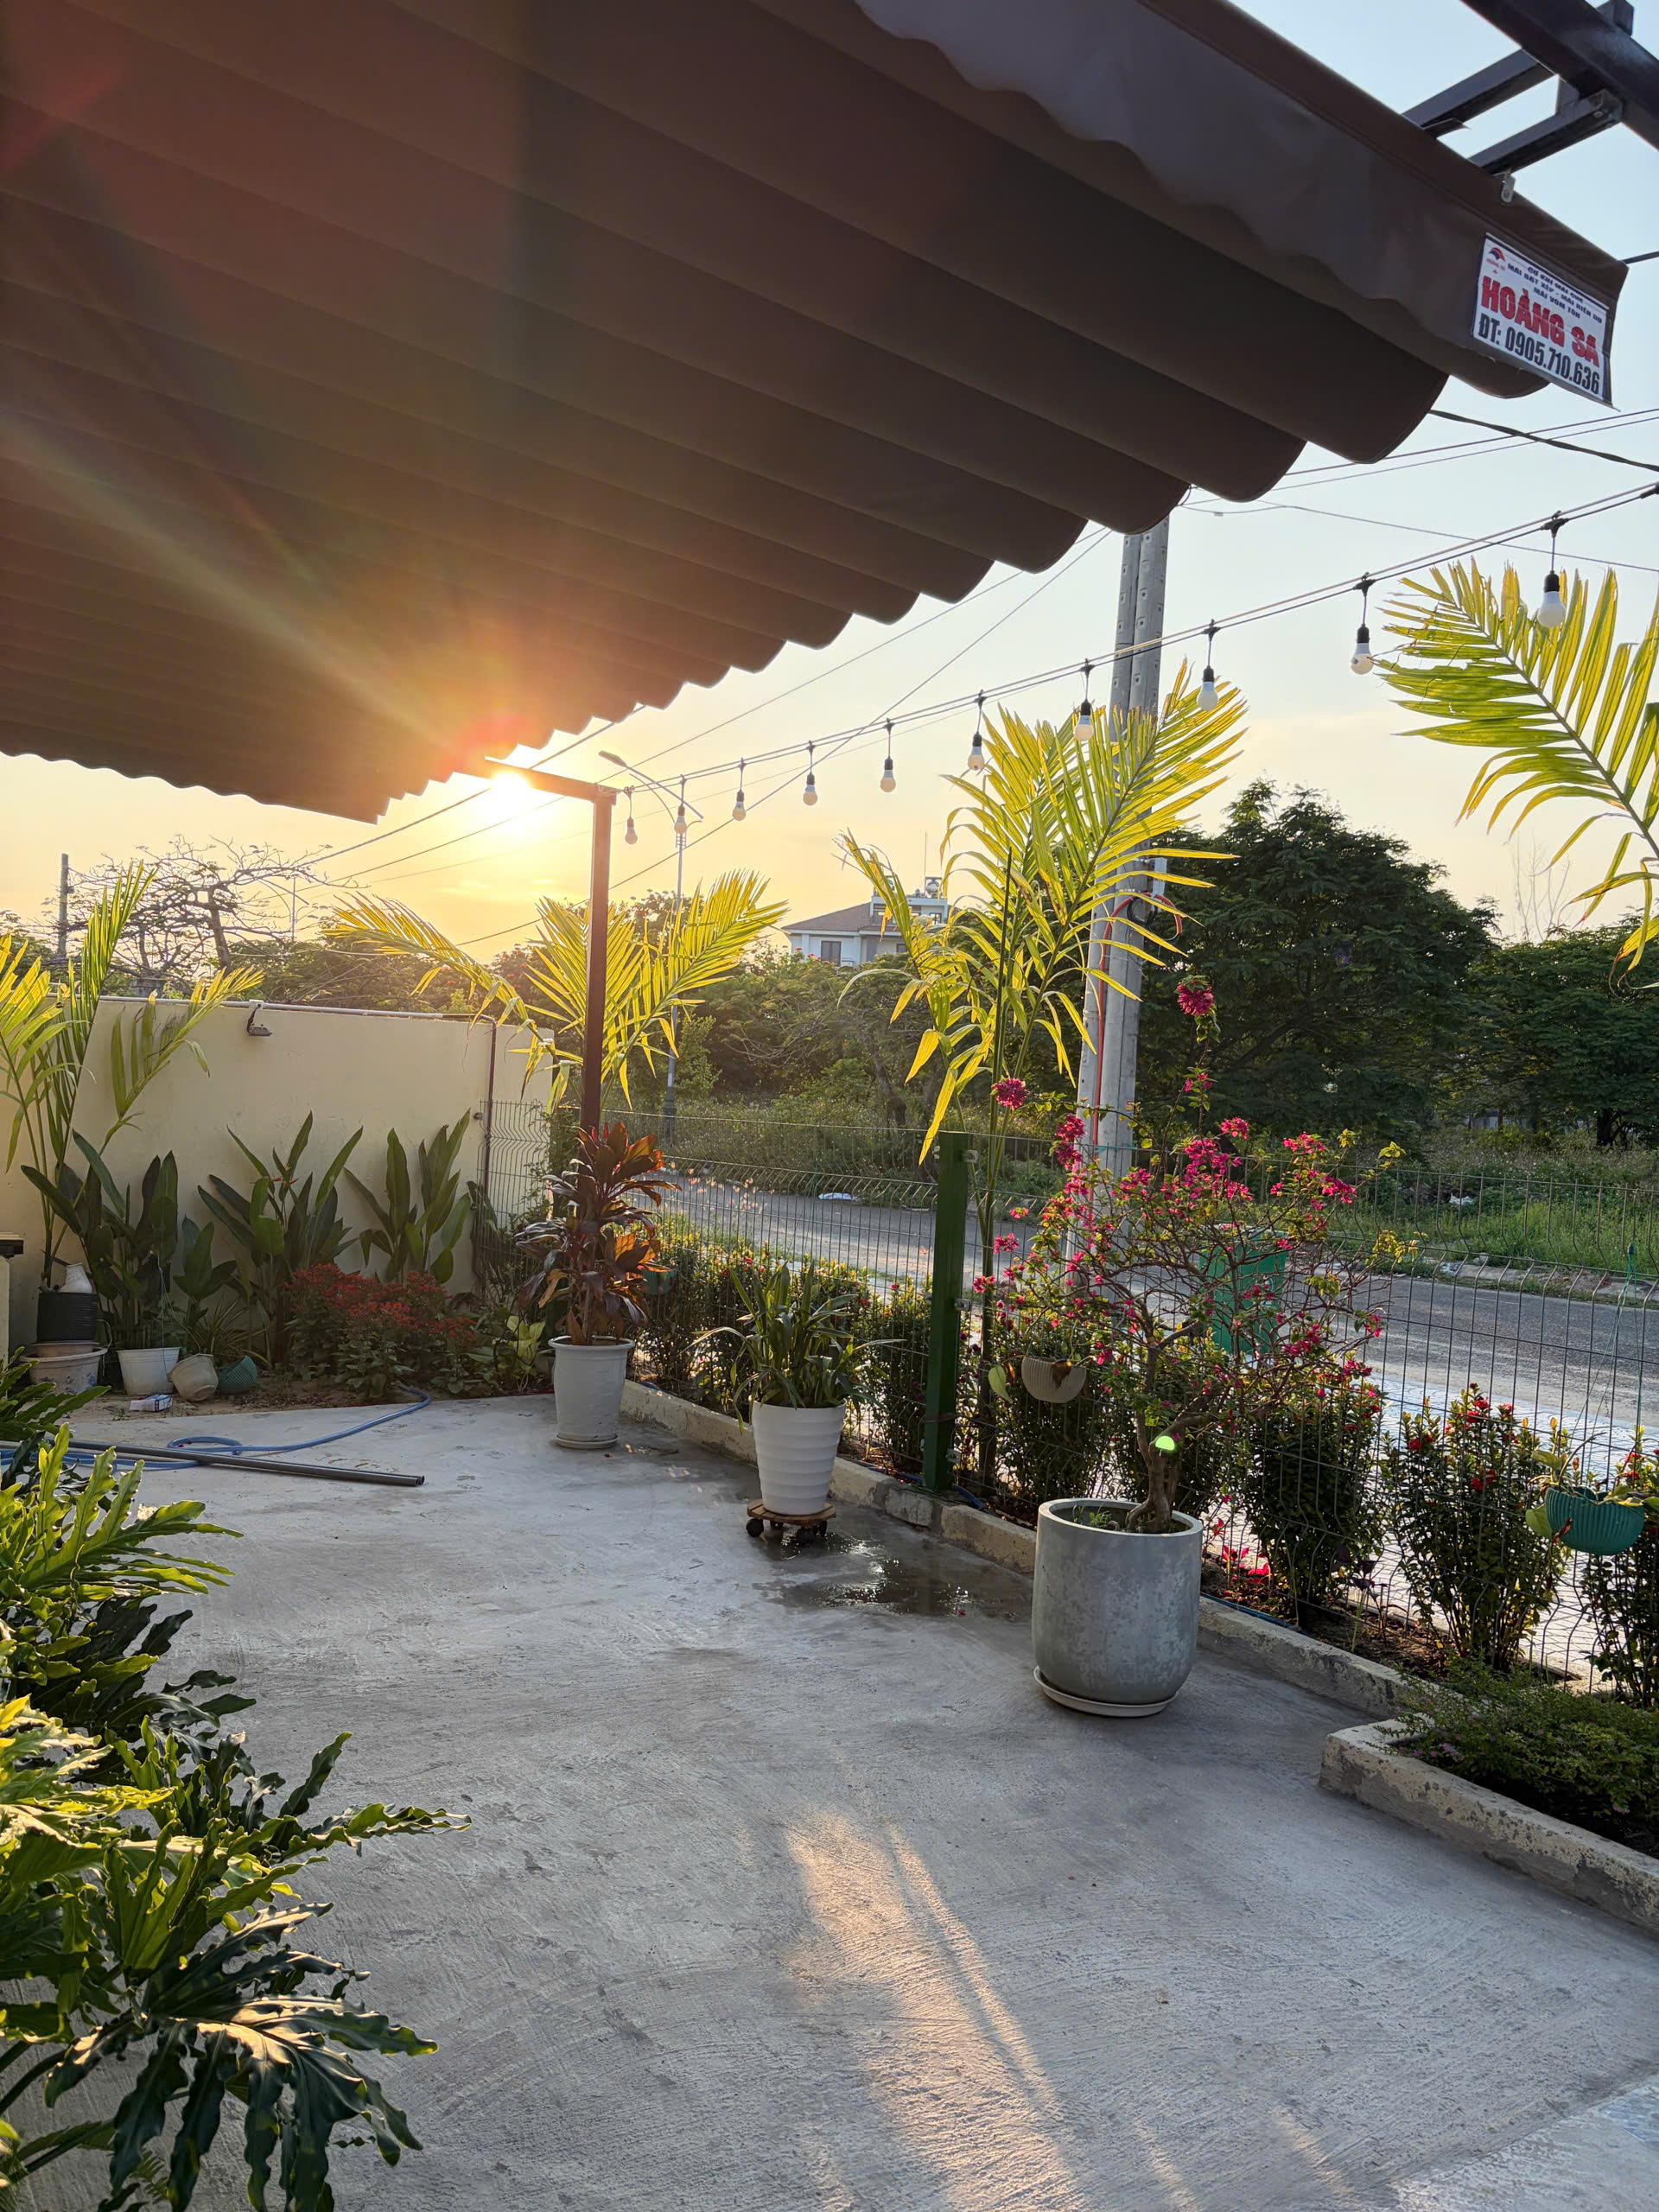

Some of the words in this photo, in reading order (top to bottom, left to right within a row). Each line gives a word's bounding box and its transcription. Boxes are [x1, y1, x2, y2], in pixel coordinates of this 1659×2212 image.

[1478, 313, 1501, 345] ĐT:
[1505, 327, 1600, 394] 0905.710.636
[1481, 276, 1565, 347] HOÀNG
[1571, 326, 1599, 368] SA
